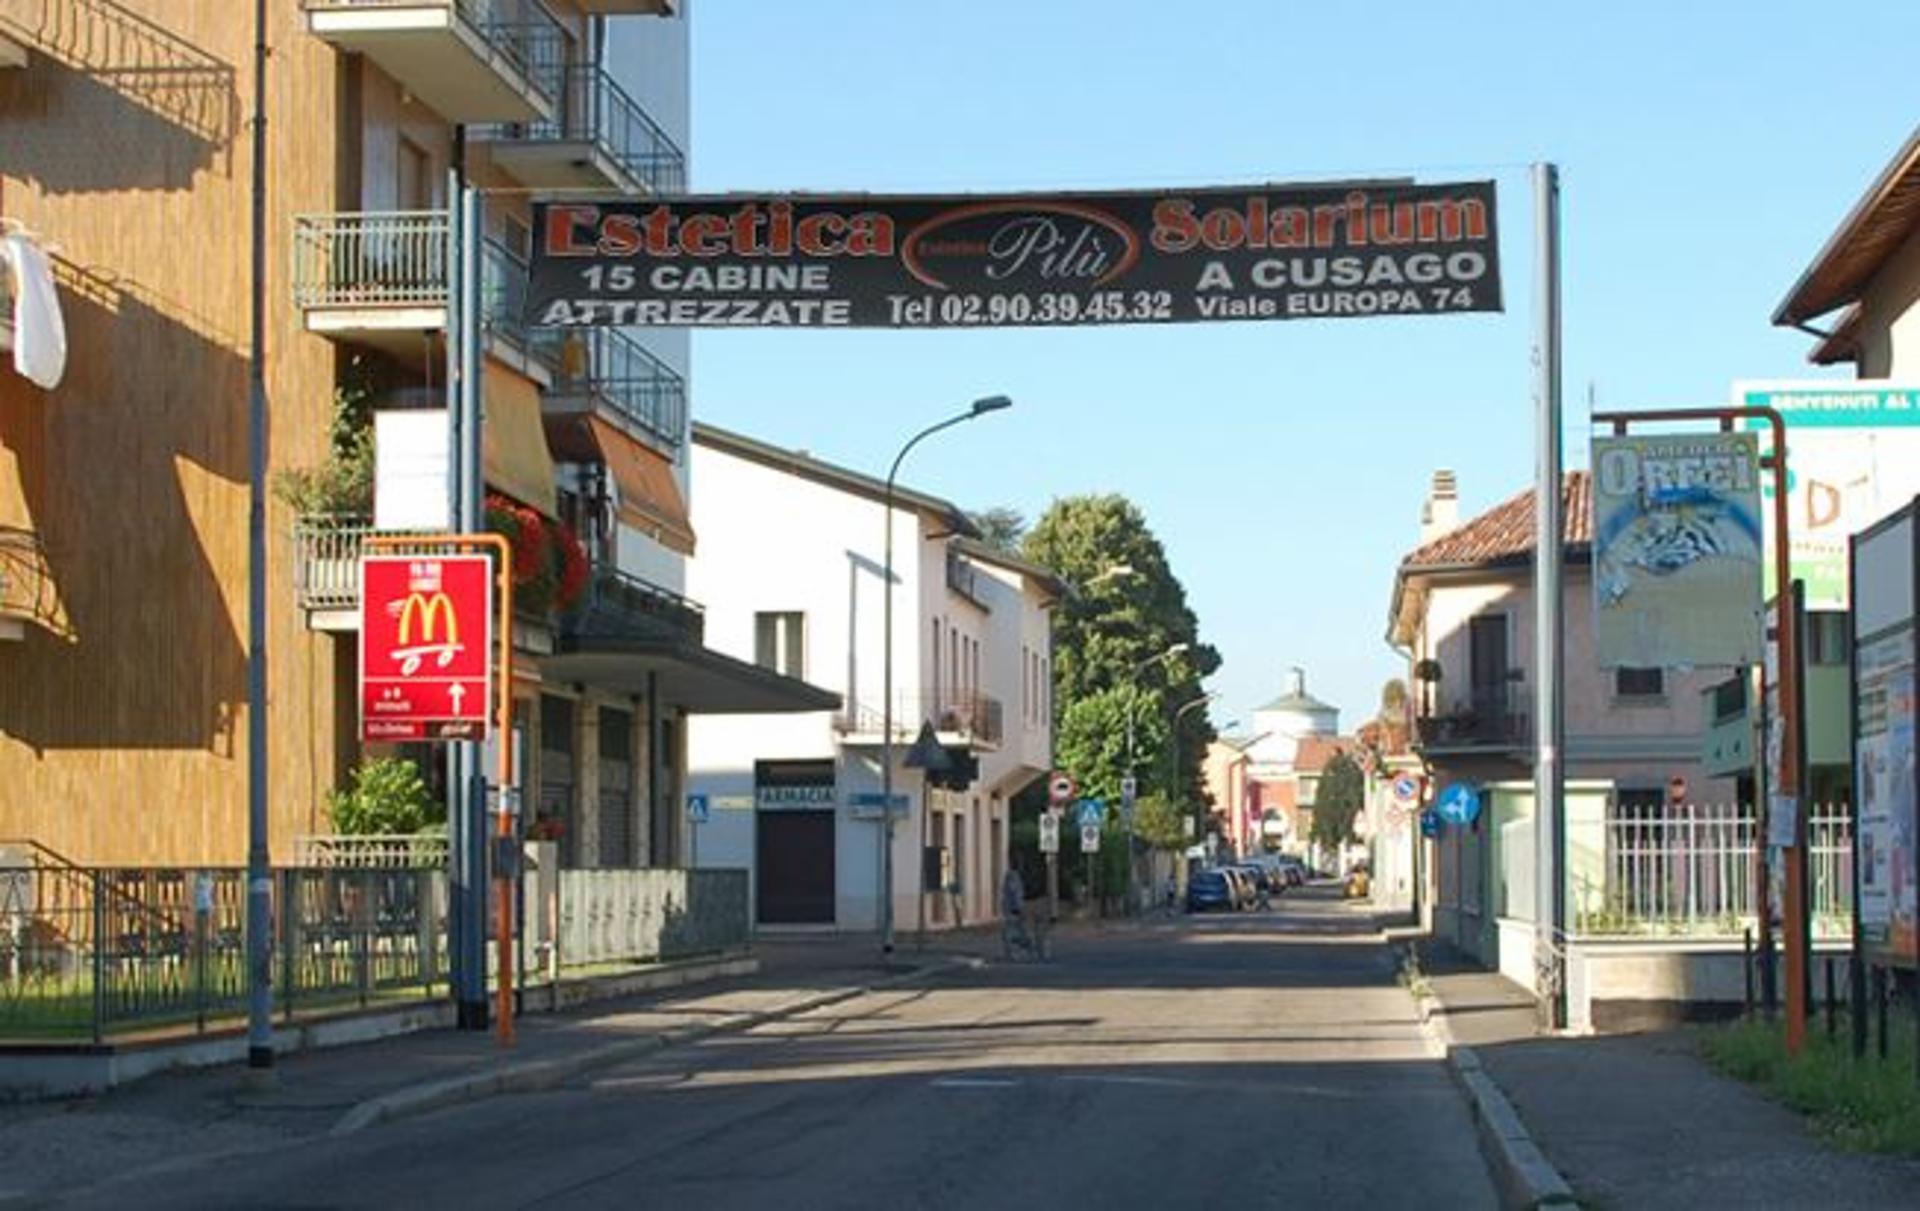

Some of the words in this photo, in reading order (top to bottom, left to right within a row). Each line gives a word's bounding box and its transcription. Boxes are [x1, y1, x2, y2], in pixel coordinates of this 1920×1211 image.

[545, 201, 894, 258] Estetica
[1151, 191, 1486, 253] Solarium
[985, 217, 1107, 279] Pilù
[580, 266, 634, 290] 15
[650, 266, 830, 291] CABINE
[1196, 262, 1233, 291] A
[1251, 252, 1486, 289] CUSAGO
[541, 300, 851, 326] ATTREZZATE
[888, 295, 932, 324] Tel
[940, 291, 1172, 323] 02.90.39.45.32
[1196, 297, 1276, 318] Viale
[1287, 289, 1422, 315] EUROPA
[1432, 287, 1473, 309] 74
